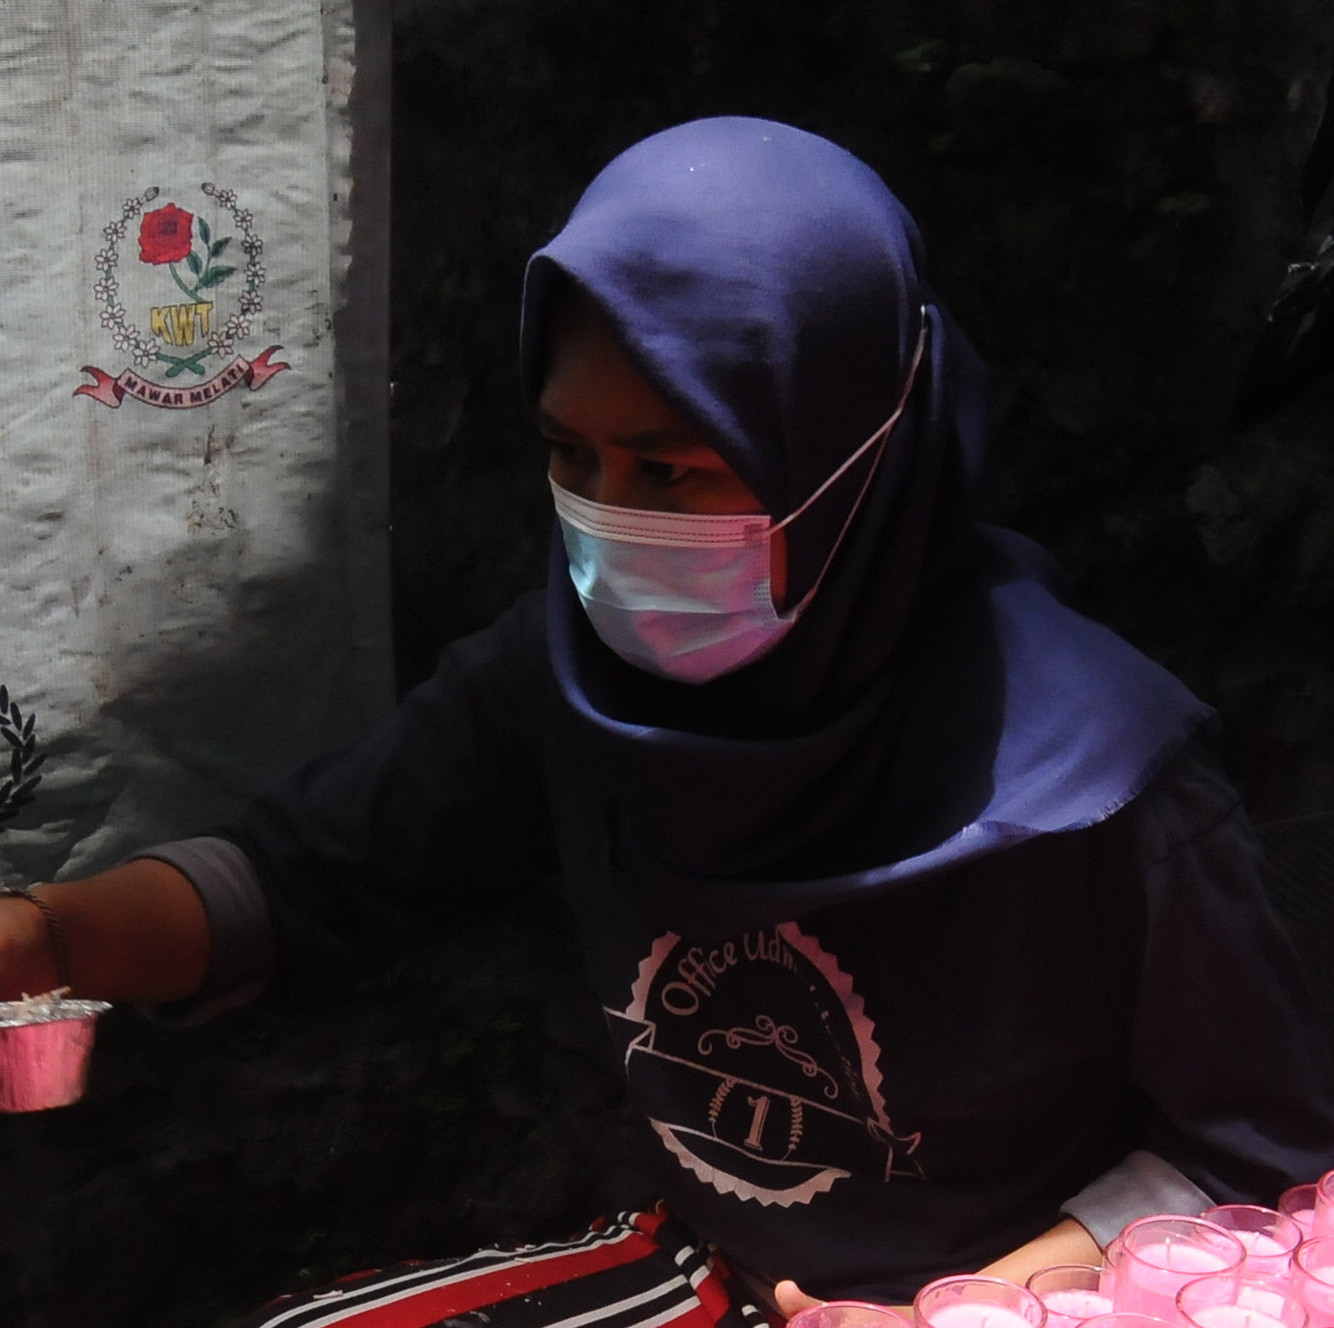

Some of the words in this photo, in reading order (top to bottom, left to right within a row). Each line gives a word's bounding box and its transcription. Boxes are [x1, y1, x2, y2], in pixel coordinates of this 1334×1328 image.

[150, 301, 213, 347] KWT
[124, 375, 184, 405] MAWAR
[189, 364, 245, 404] MELATI
[661, 941, 737, 1016] Office
